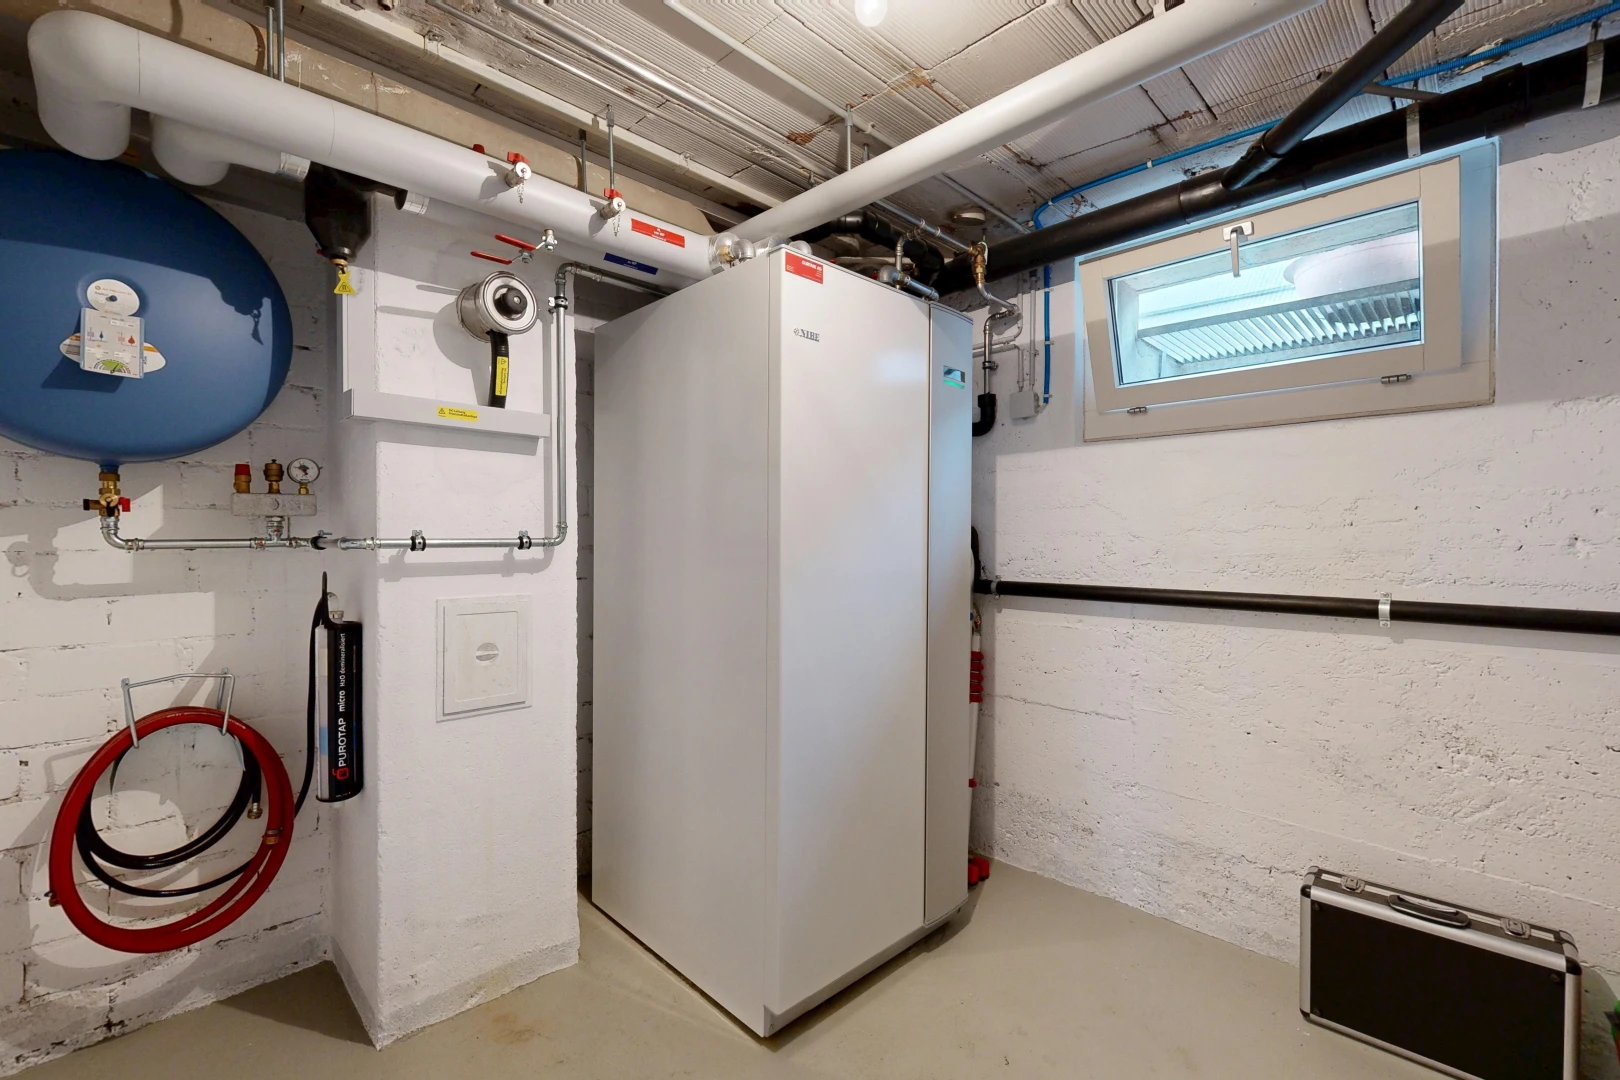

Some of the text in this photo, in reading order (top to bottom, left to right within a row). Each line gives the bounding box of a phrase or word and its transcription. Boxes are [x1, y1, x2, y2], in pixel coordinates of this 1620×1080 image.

[799, 328, 820, 342] NIBE
[338, 690, 346, 712] micro
[338, 717, 347, 767] PUROTAP
